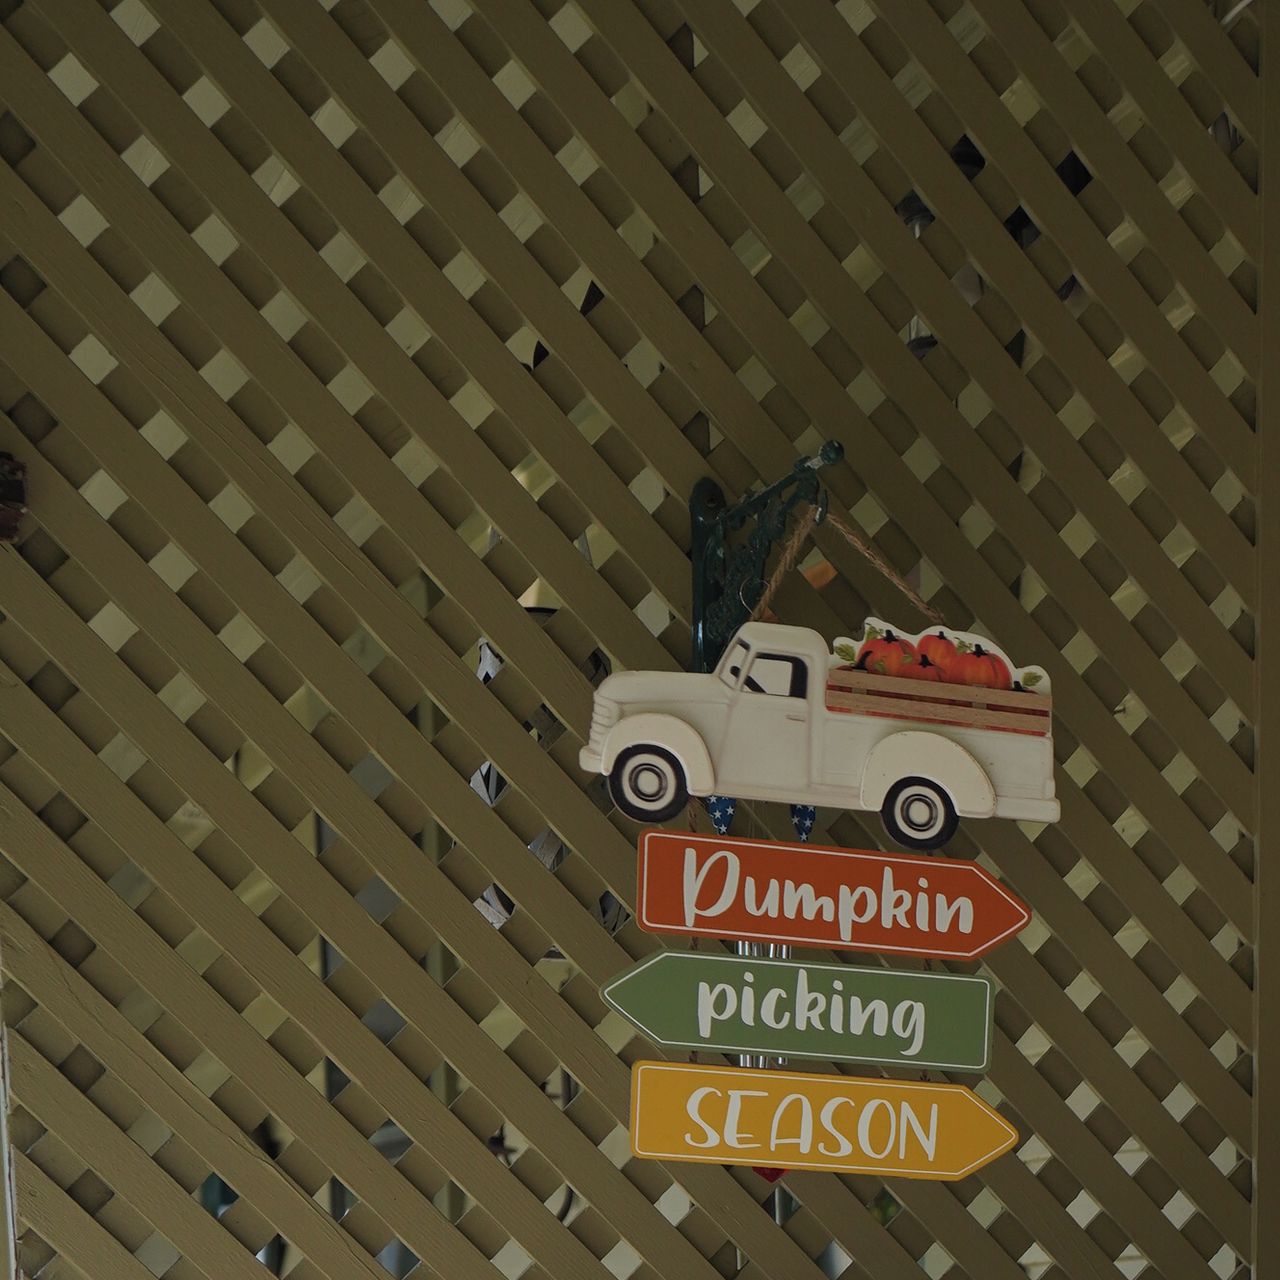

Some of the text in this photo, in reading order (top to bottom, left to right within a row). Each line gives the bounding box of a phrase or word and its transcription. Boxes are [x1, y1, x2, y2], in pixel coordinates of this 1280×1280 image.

[683, 846, 975, 942] Pumpkin
[697, 968, 926, 1056] picking
[684, 1086, 939, 1162] SEASON
